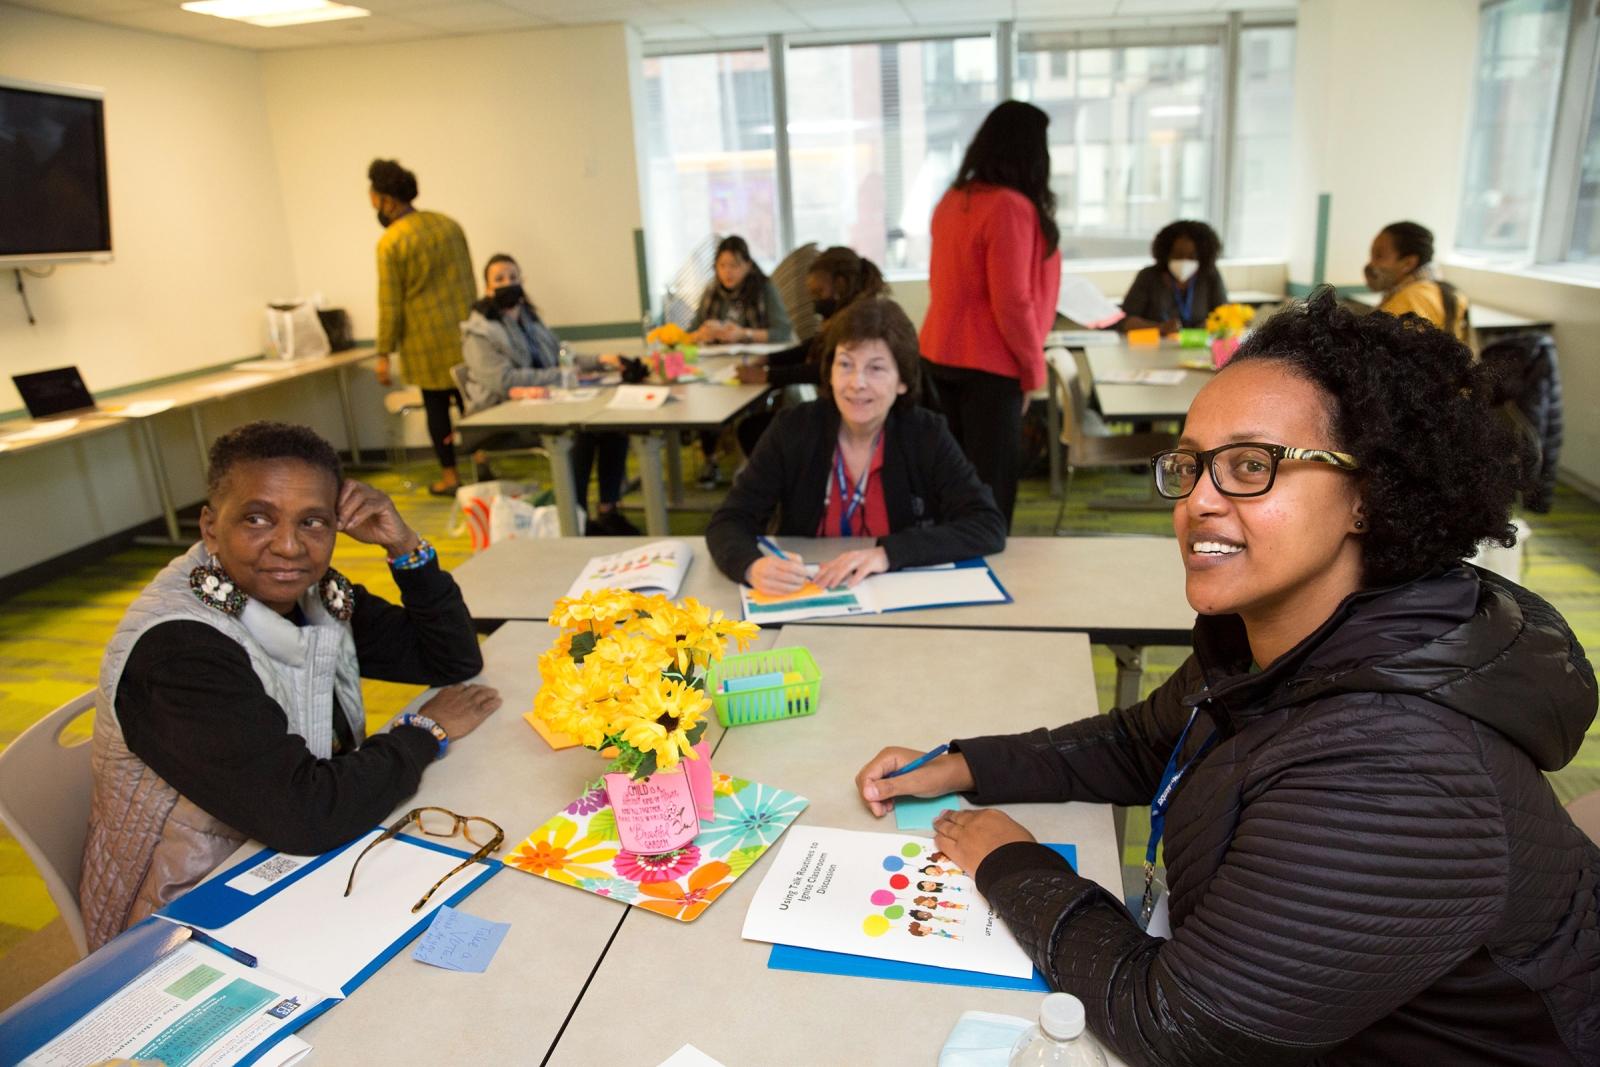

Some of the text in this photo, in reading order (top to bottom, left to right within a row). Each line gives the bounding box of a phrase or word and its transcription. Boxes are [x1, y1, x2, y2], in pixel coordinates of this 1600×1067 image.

[778, 890, 798, 911] Using
[789, 877, 802, 889] Talk
[796, 850, 815, 876] Routines
[797, 852, 828, 902] Ignite Classroom
[816, 864, 837, 895] Discussion
[986, 916, 994, 927] Early
[162, 1002, 182, 1016] Why
[135, 1023, 154, 1036] this
